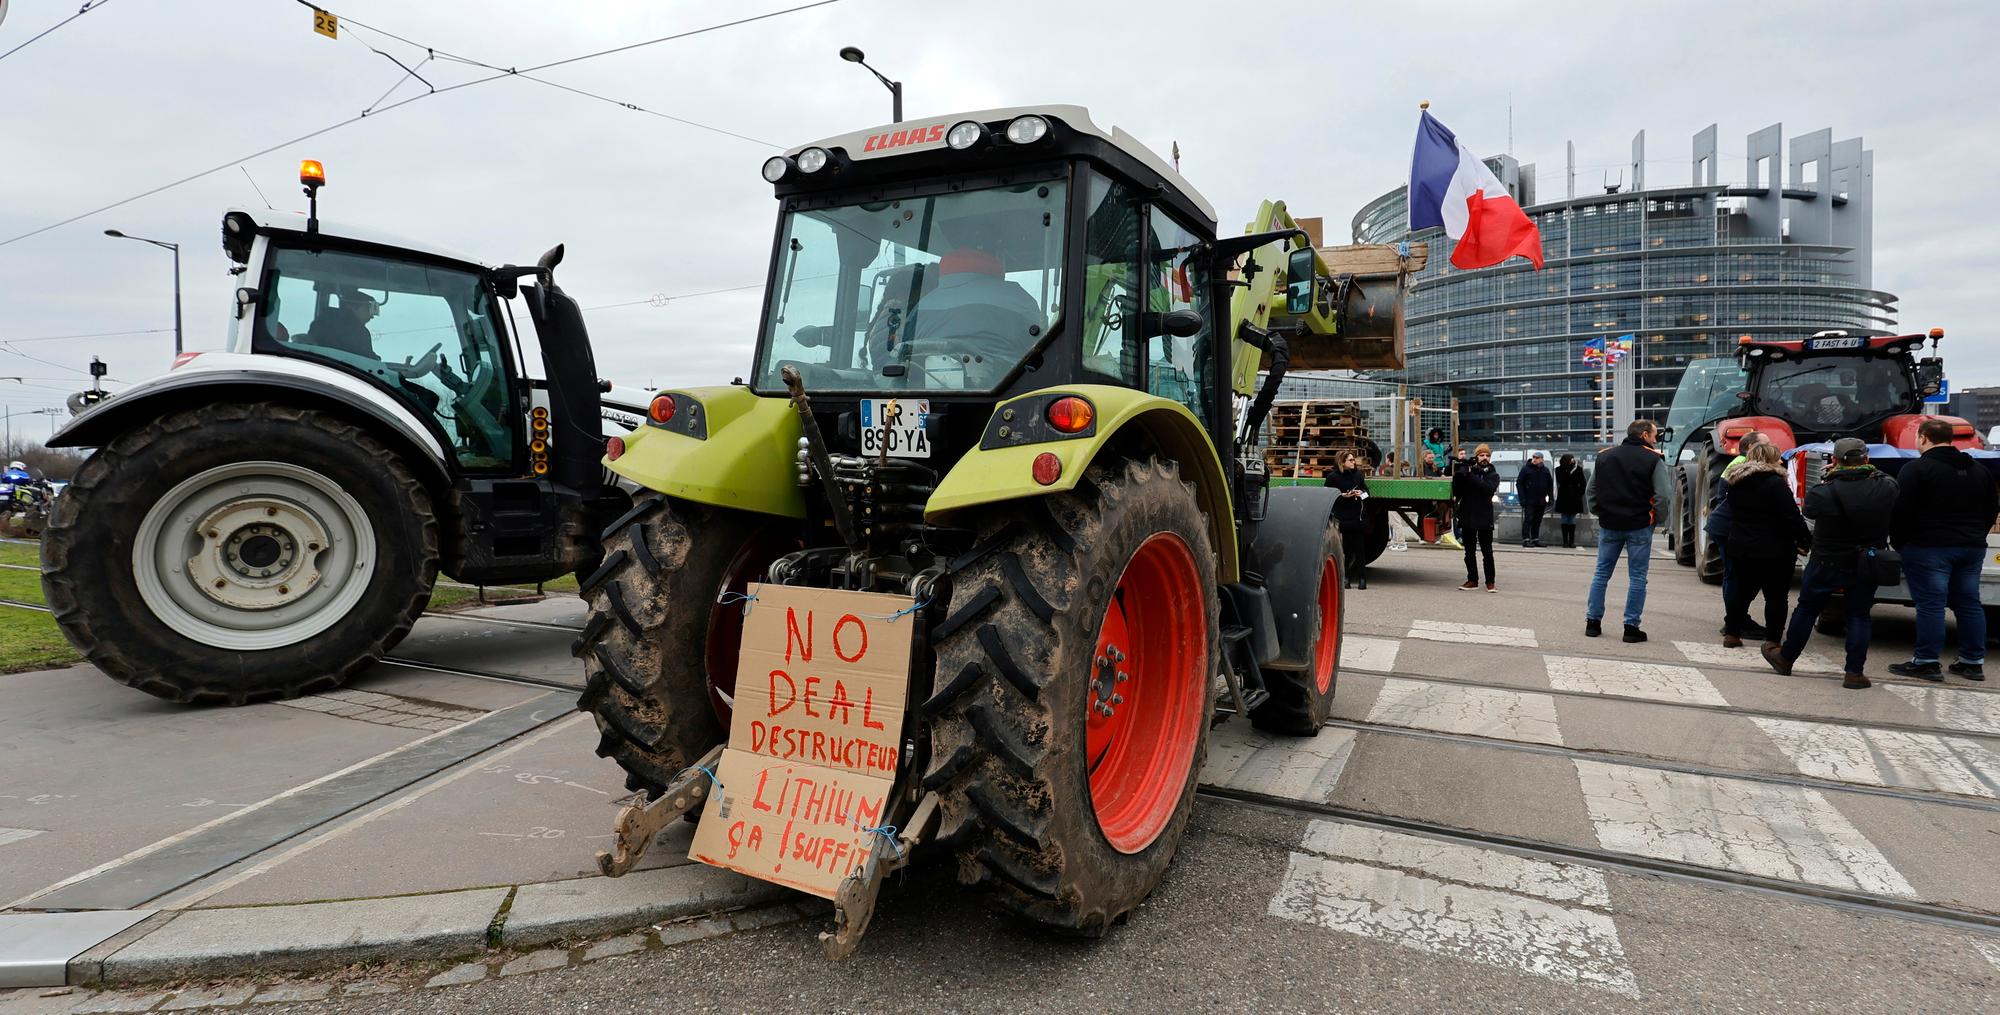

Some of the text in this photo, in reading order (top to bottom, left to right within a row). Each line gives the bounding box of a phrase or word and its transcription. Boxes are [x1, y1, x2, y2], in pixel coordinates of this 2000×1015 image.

[316, 16, 336, 33] 25
[864, 124, 945, 152] CLAAS
[1822, 340, 1841, 348] FAST
[785, 607, 868, 665] NO
[768, 669, 884, 731] DEAL
[751, 720, 899, 772] DESTRUCTEUR
